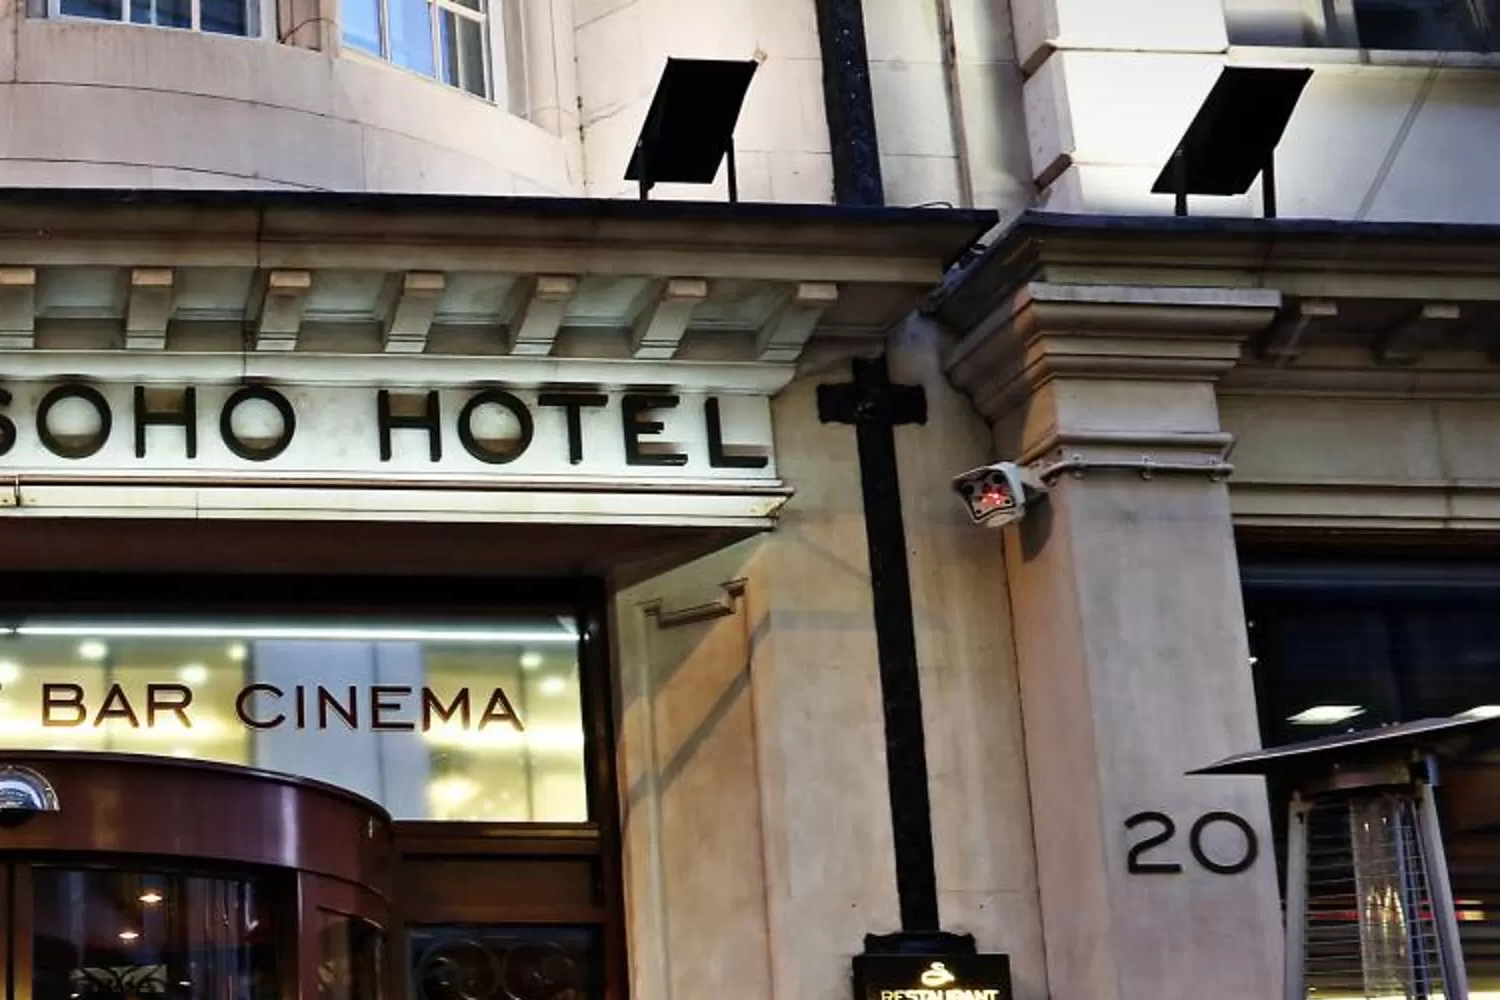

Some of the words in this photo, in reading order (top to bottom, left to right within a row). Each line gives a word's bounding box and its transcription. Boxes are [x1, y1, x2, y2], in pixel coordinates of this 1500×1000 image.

[377, 388, 768, 468] HOTEL
[41, 683, 194, 729] BAR
[235, 684, 525, 732] CINEMA
[1124, 811, 1259, 875] 20
